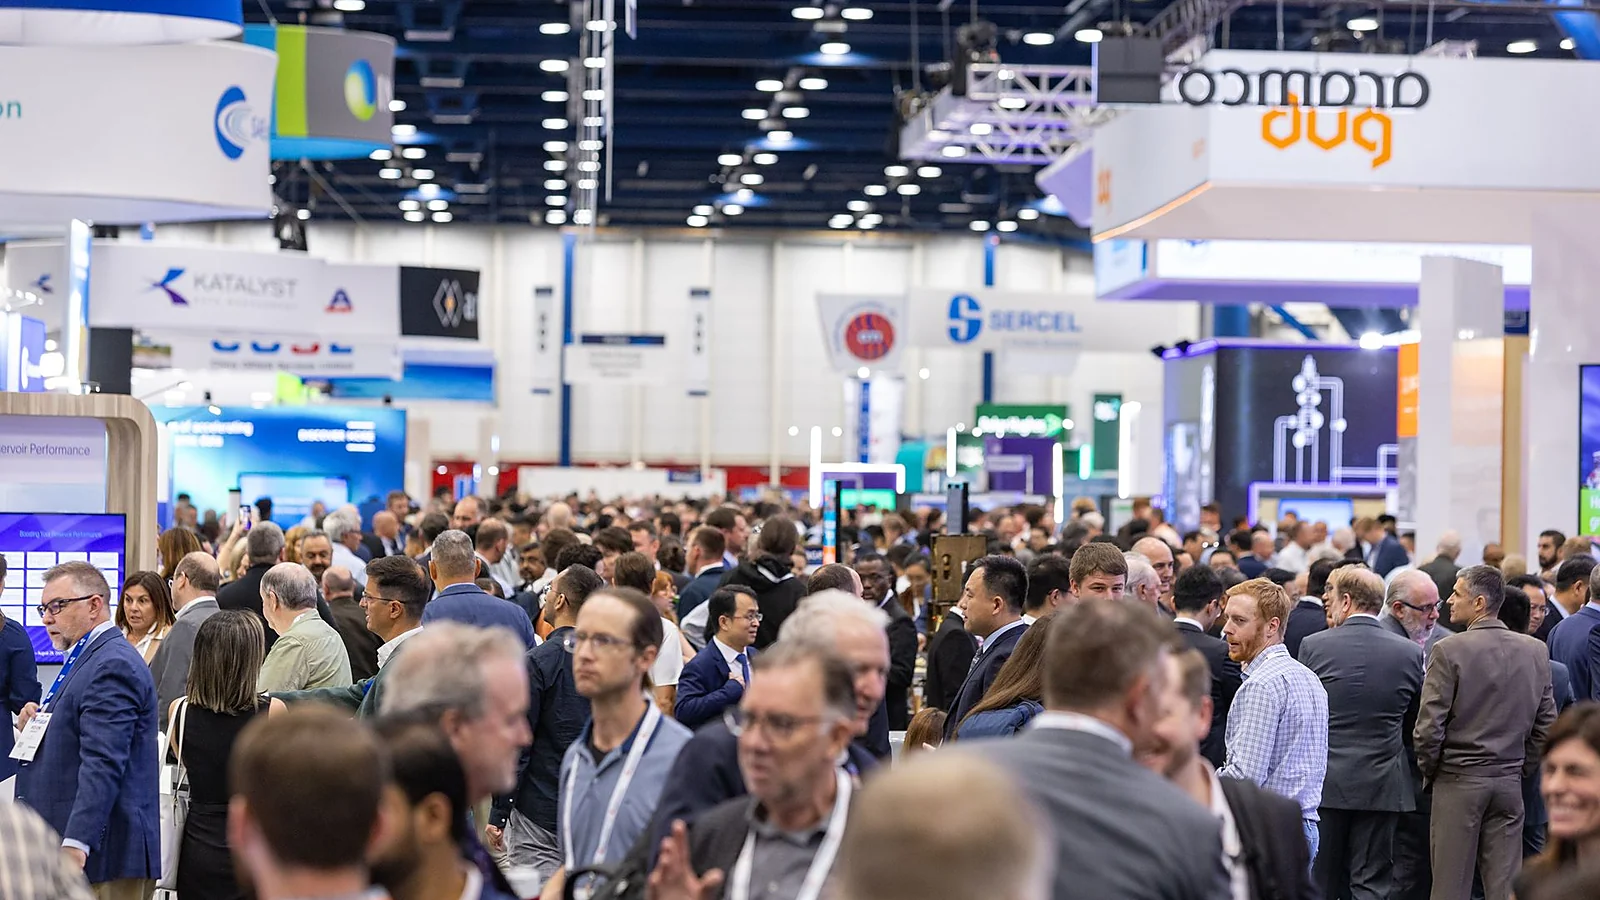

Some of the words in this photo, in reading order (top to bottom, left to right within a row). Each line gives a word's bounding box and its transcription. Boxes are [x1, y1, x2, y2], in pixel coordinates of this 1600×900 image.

[0, 101, 21, 119] n
[1261, 91, 1392, 169] dug
[193, 272, 299, 298] KATALYST
[989, 310, 1082, 332] SERCEL
[0, 444, 27, 455] ervoir
[30, 443, 91, 456] Performance
